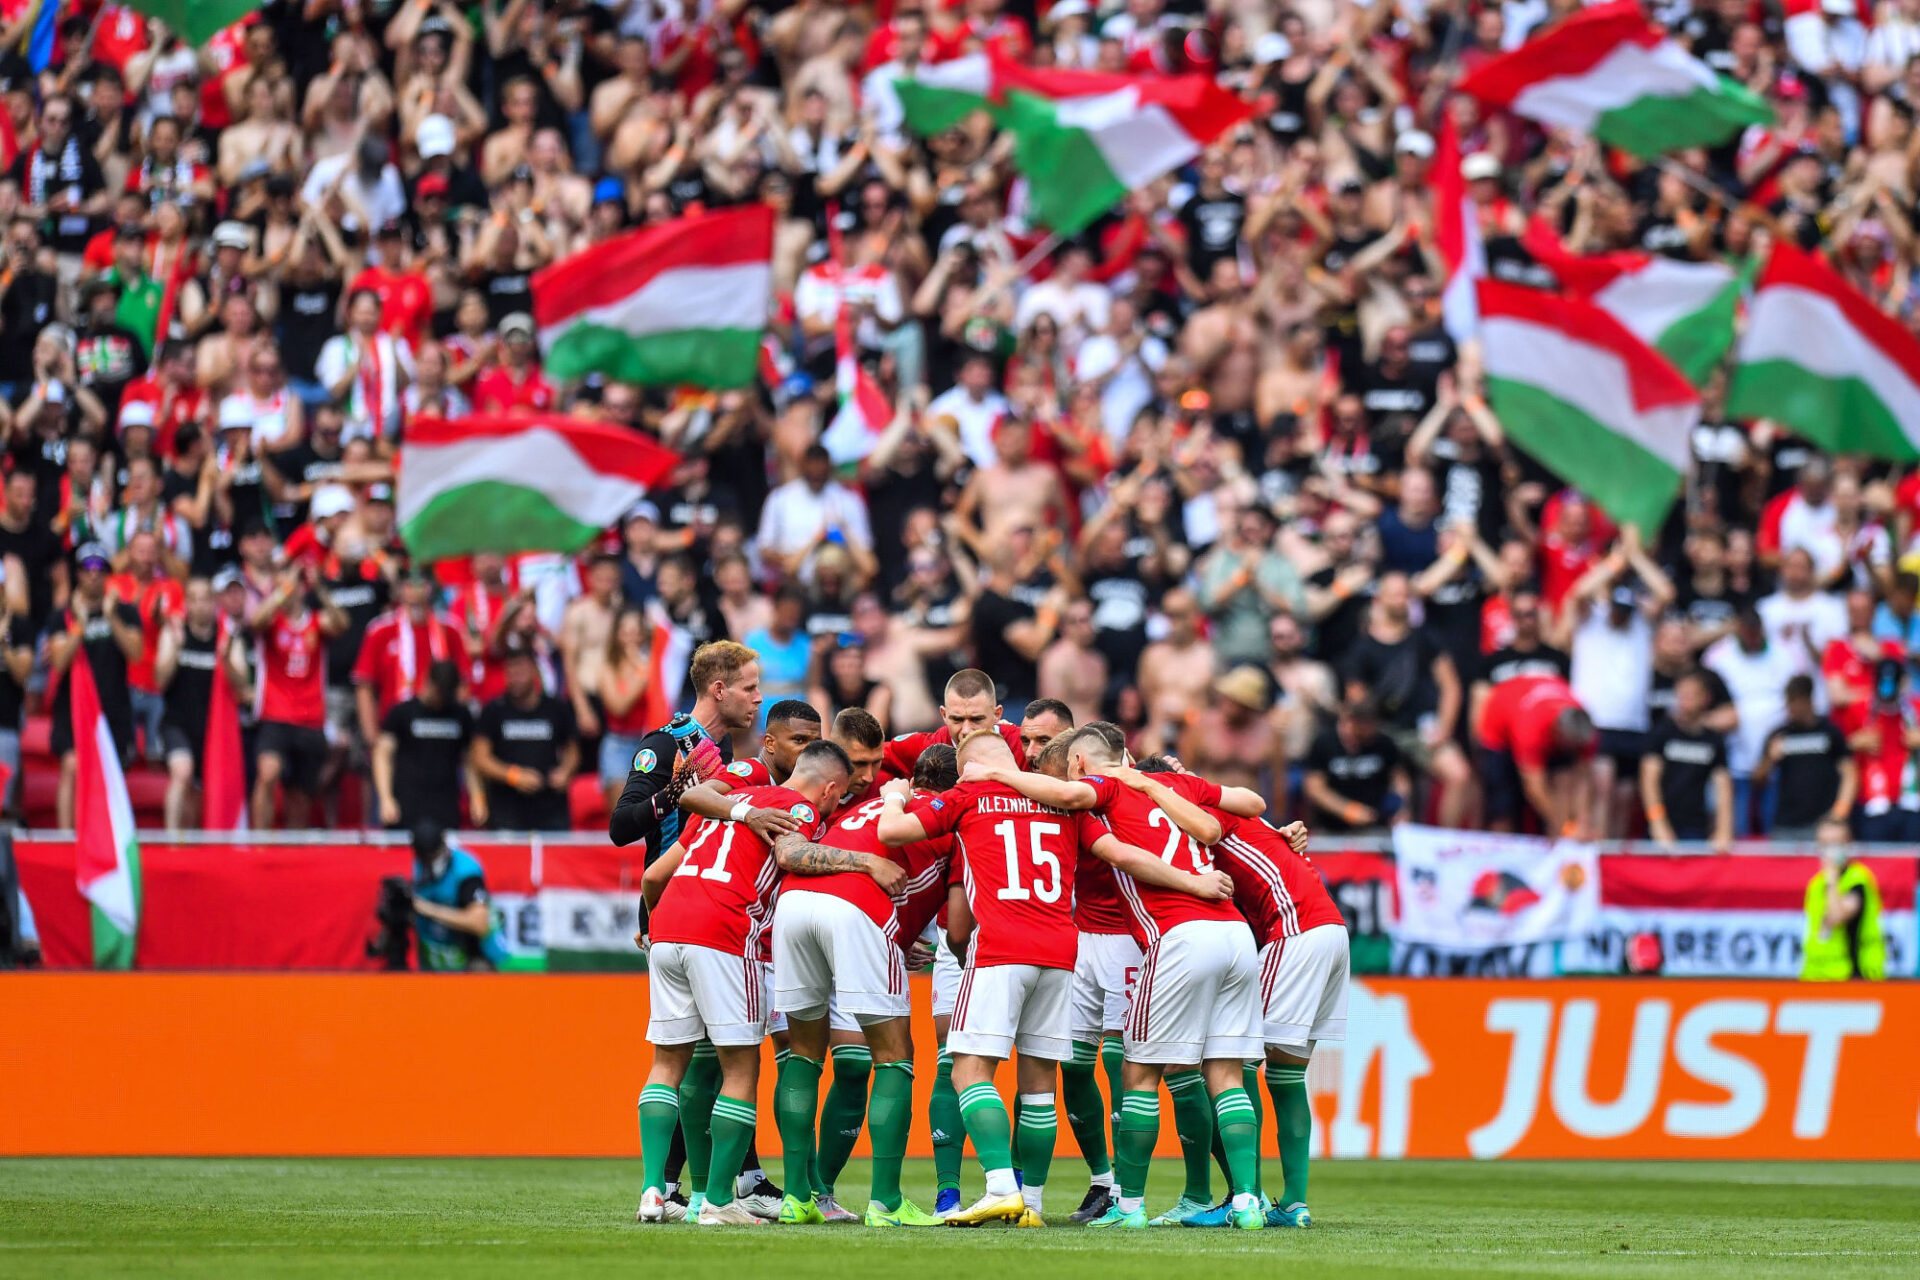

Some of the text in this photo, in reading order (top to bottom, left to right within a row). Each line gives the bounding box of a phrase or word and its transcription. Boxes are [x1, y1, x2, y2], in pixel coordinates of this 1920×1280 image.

[672, 818, 737, 884] 21
[994, 819, 1063, 904] 15
[1124, 966, 1139, 1000] 5
[1466, 999, 1884, 1160] JUST
